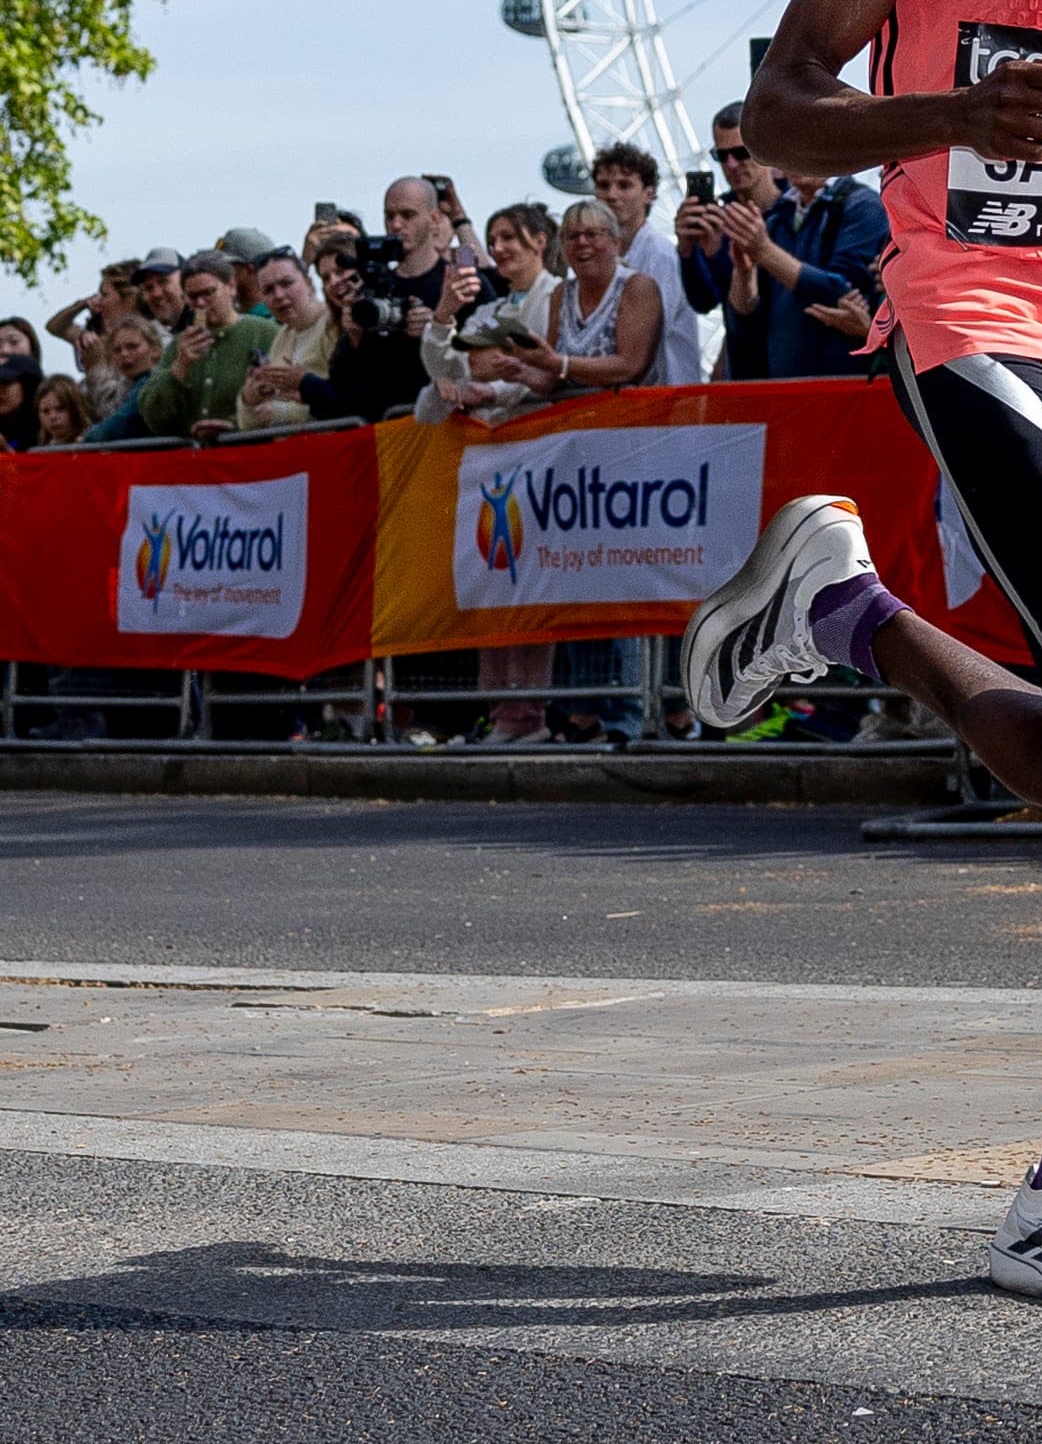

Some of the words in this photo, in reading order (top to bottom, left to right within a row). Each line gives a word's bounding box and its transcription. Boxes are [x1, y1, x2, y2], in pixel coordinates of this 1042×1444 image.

[526, 461, 709, 531] Voltarol
[177, 512, 283, 571] Voltarol
[536, 544, 560, 568] The
[562, 545, 584, 571] joy
[588, 543, 604, 566] of
[608, 544, 703, 566] movement
